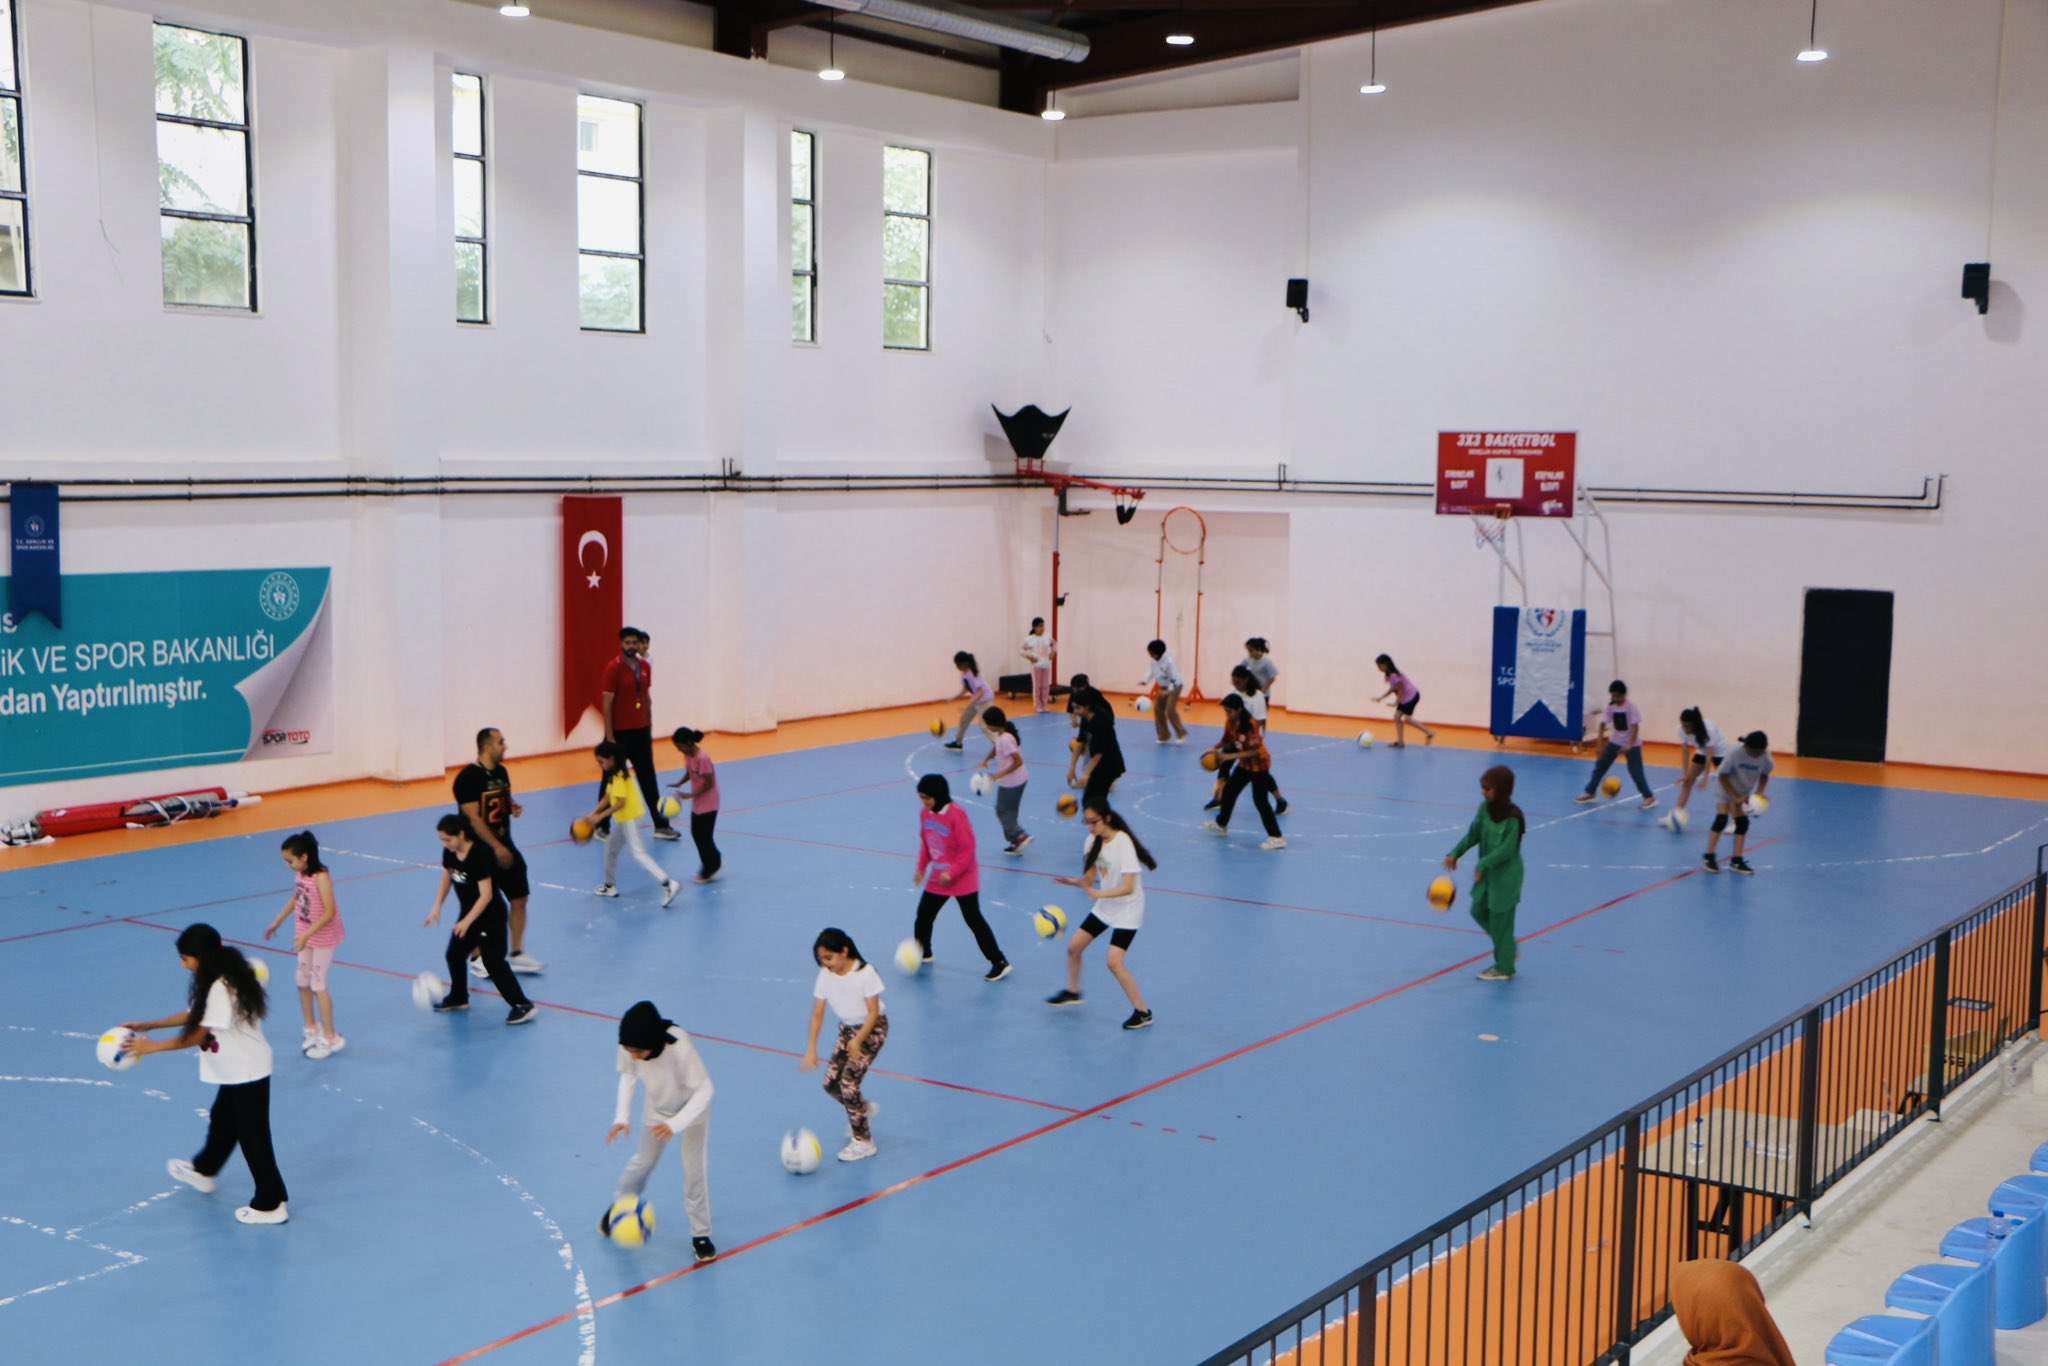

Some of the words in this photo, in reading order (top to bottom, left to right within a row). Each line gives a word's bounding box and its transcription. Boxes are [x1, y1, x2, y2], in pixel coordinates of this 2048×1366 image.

[1485, 434, 1556, 447] BASKETBOL
[32, 645, 67, 674] VE
[75, 641, 146, 671] SPOR
[153, 629, 274, 666] BAKANLIĞI
[51, 676, 207, 716] Yaptırılmıştır.
[262, 732, 287, 745] SPOR
[287, 731, 310, 742] TOTO
